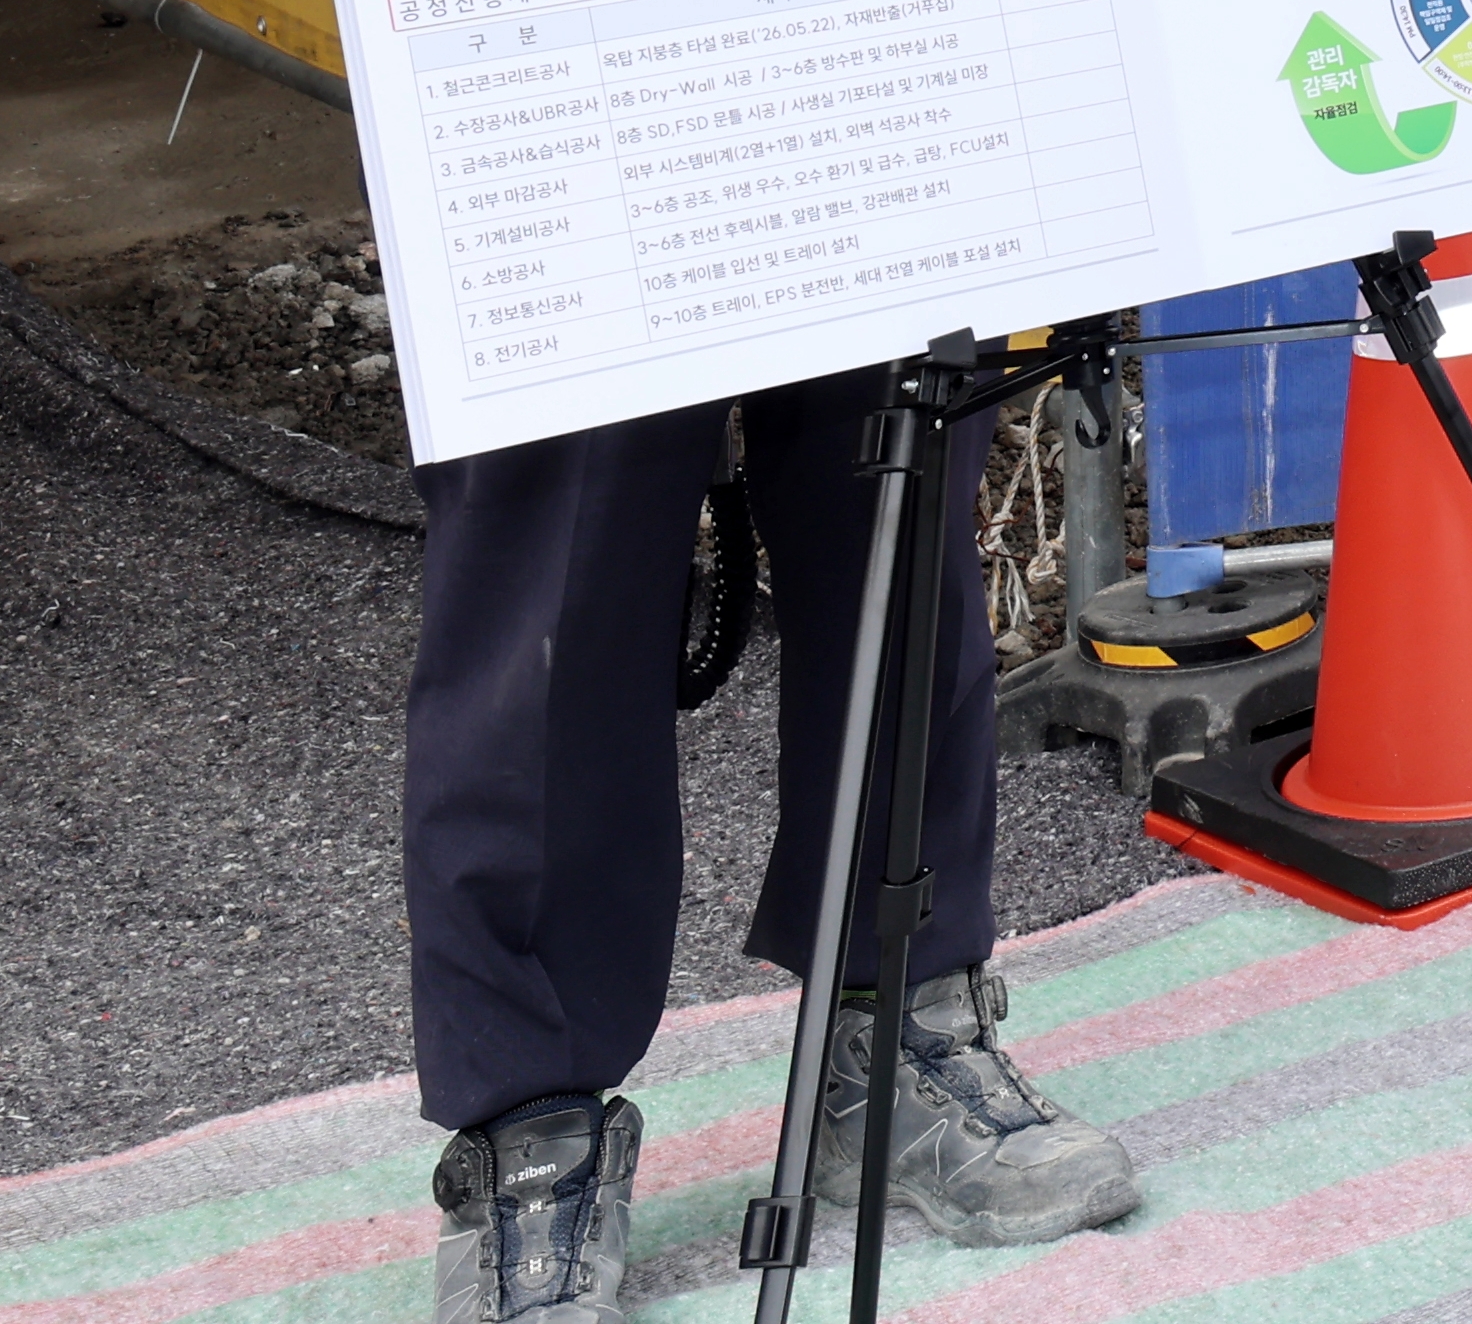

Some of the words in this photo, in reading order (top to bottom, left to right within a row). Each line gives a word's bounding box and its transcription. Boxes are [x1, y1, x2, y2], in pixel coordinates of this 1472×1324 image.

[603, 49, 633, 69] 옥탑
[637, 42, 683, 62] 지붕층
[686, 35, 717, 54] 타설
[1307, 44, 1344, 71] 관리
[425, 85, 439, 99] 1.
[443, 61, 570, 97] 철근콘크리트공사
[1302, 68, 1357, 98] 감독자
[433, 125, 449, 140] 2.
[454, 97, 599, 136] 수장공사&UBR공사
[1314, 101, 1358, 120] 자율점검
[440, 162, 456, 178] 3.
[462, 135, 600, 174] 금속공사&습식공사
[623, 162, 654, 181] 외부
[660, 135, 804, 174] 시스템비계(2열+1열)
[808, 127, 842, 147] 설치,
[846, 120, 875, 139] 외벽
[878, 112, 920, 133] 석공사
[923, 107, 952, 124] 착수
[630, 196, 679, 218] 3~6층
[683, 189, 718, 209] 공조,
[722, 181, 752, 201] 위생
[756, 175, 790, 195] 우수,
[794, 168, 824, 187] 오수
[826, 160, 856, 181] 환기
[858, 157, 874, 175] 및
[877, 152, 910, 172] 급수,
[914, 144, 946, 165] 급탕,
[949, 131, 1009, 156] FCU설치
[447, 200, 464, 215] 4.
[468, 191, 500, 211] 외부
[504, 178, 568, 204] 마감공사
[453, 237, 470, 253] 5.
[475, 217, 570, 248] 기계설비공사
[461, 276, 477, 291] 6.
[482, 260, 545, 286] 소방공사
[643, 272, 677, 292] 10층
[681, 262, 726, 284] 케이블
[730, 254, 761, 275] 입선
[763, 250, 780, 269] 및
[783, 241, 827, 263] 트레이
[831, 234, 860, 255] 설치
[467, 313, 483, 329] 7.
[487, 291, 582, 325] 정보통신공사
[474, 351, 490, 367] 8.
[494, 335, 559, 363] 전기공사
[517, 1163, 557, 1182] ziben
